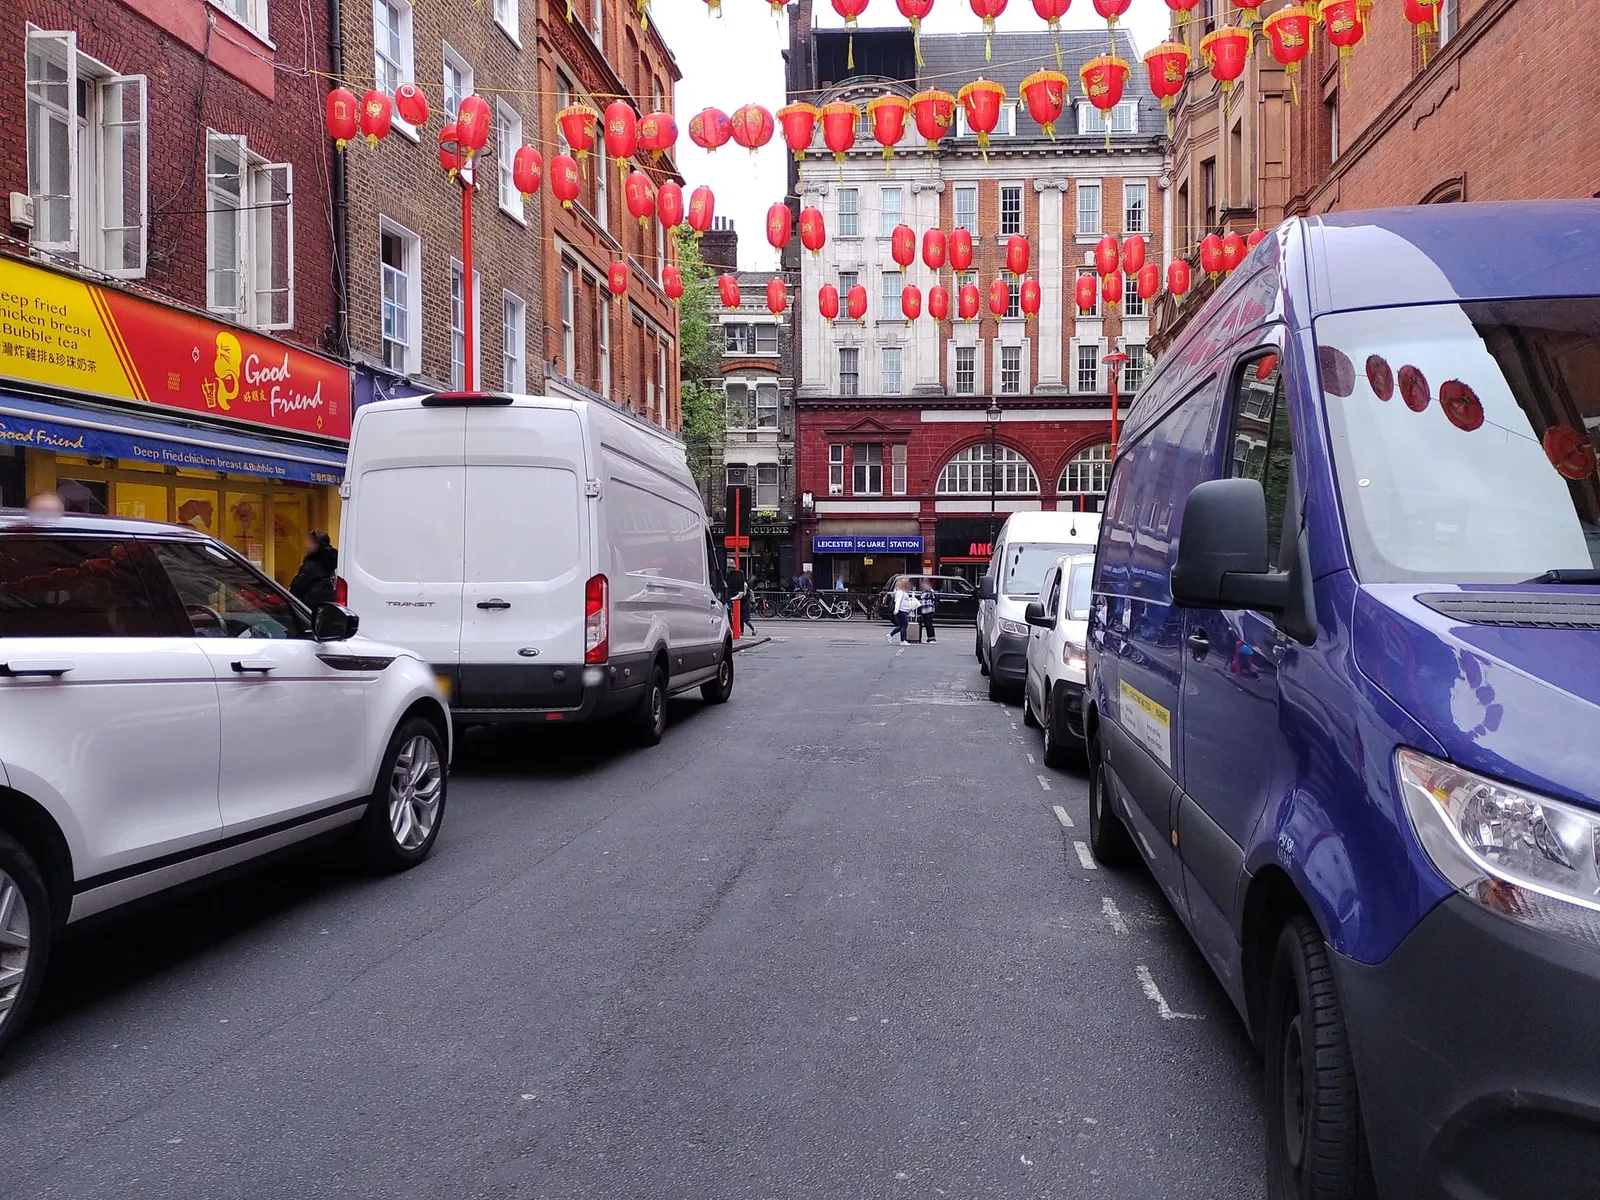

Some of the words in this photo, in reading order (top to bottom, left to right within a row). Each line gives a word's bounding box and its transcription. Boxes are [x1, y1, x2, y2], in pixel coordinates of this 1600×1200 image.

[34, 297, 67, 317] fried
[0, 322, 53, 344] Bubble
[58, 335, 78, 350] tea
[50, 317, 92, 338] breast
[0, 340, 97, 373] 灣炸雞排&珍珠奶茶
[244, 352, 291, 386] Good
[270, 380, 323, 418] Friend
[0, 422, 35, 442] Good
[36, 429, 84, 449] Friend
[133, 445, 160, 461] Deep
[162, 448, 184, 462] fried
[184, 452, 216, 466] chicken
[217, 457, 243, 470] breast
[275, 466, 286, 475] tea
[712, 526, 726, 534] TH
[750, 526, 789, 534] CUPINE
[817, 540, 853, 548] LEICESTER
[889, 540, 919, 548] STATION
